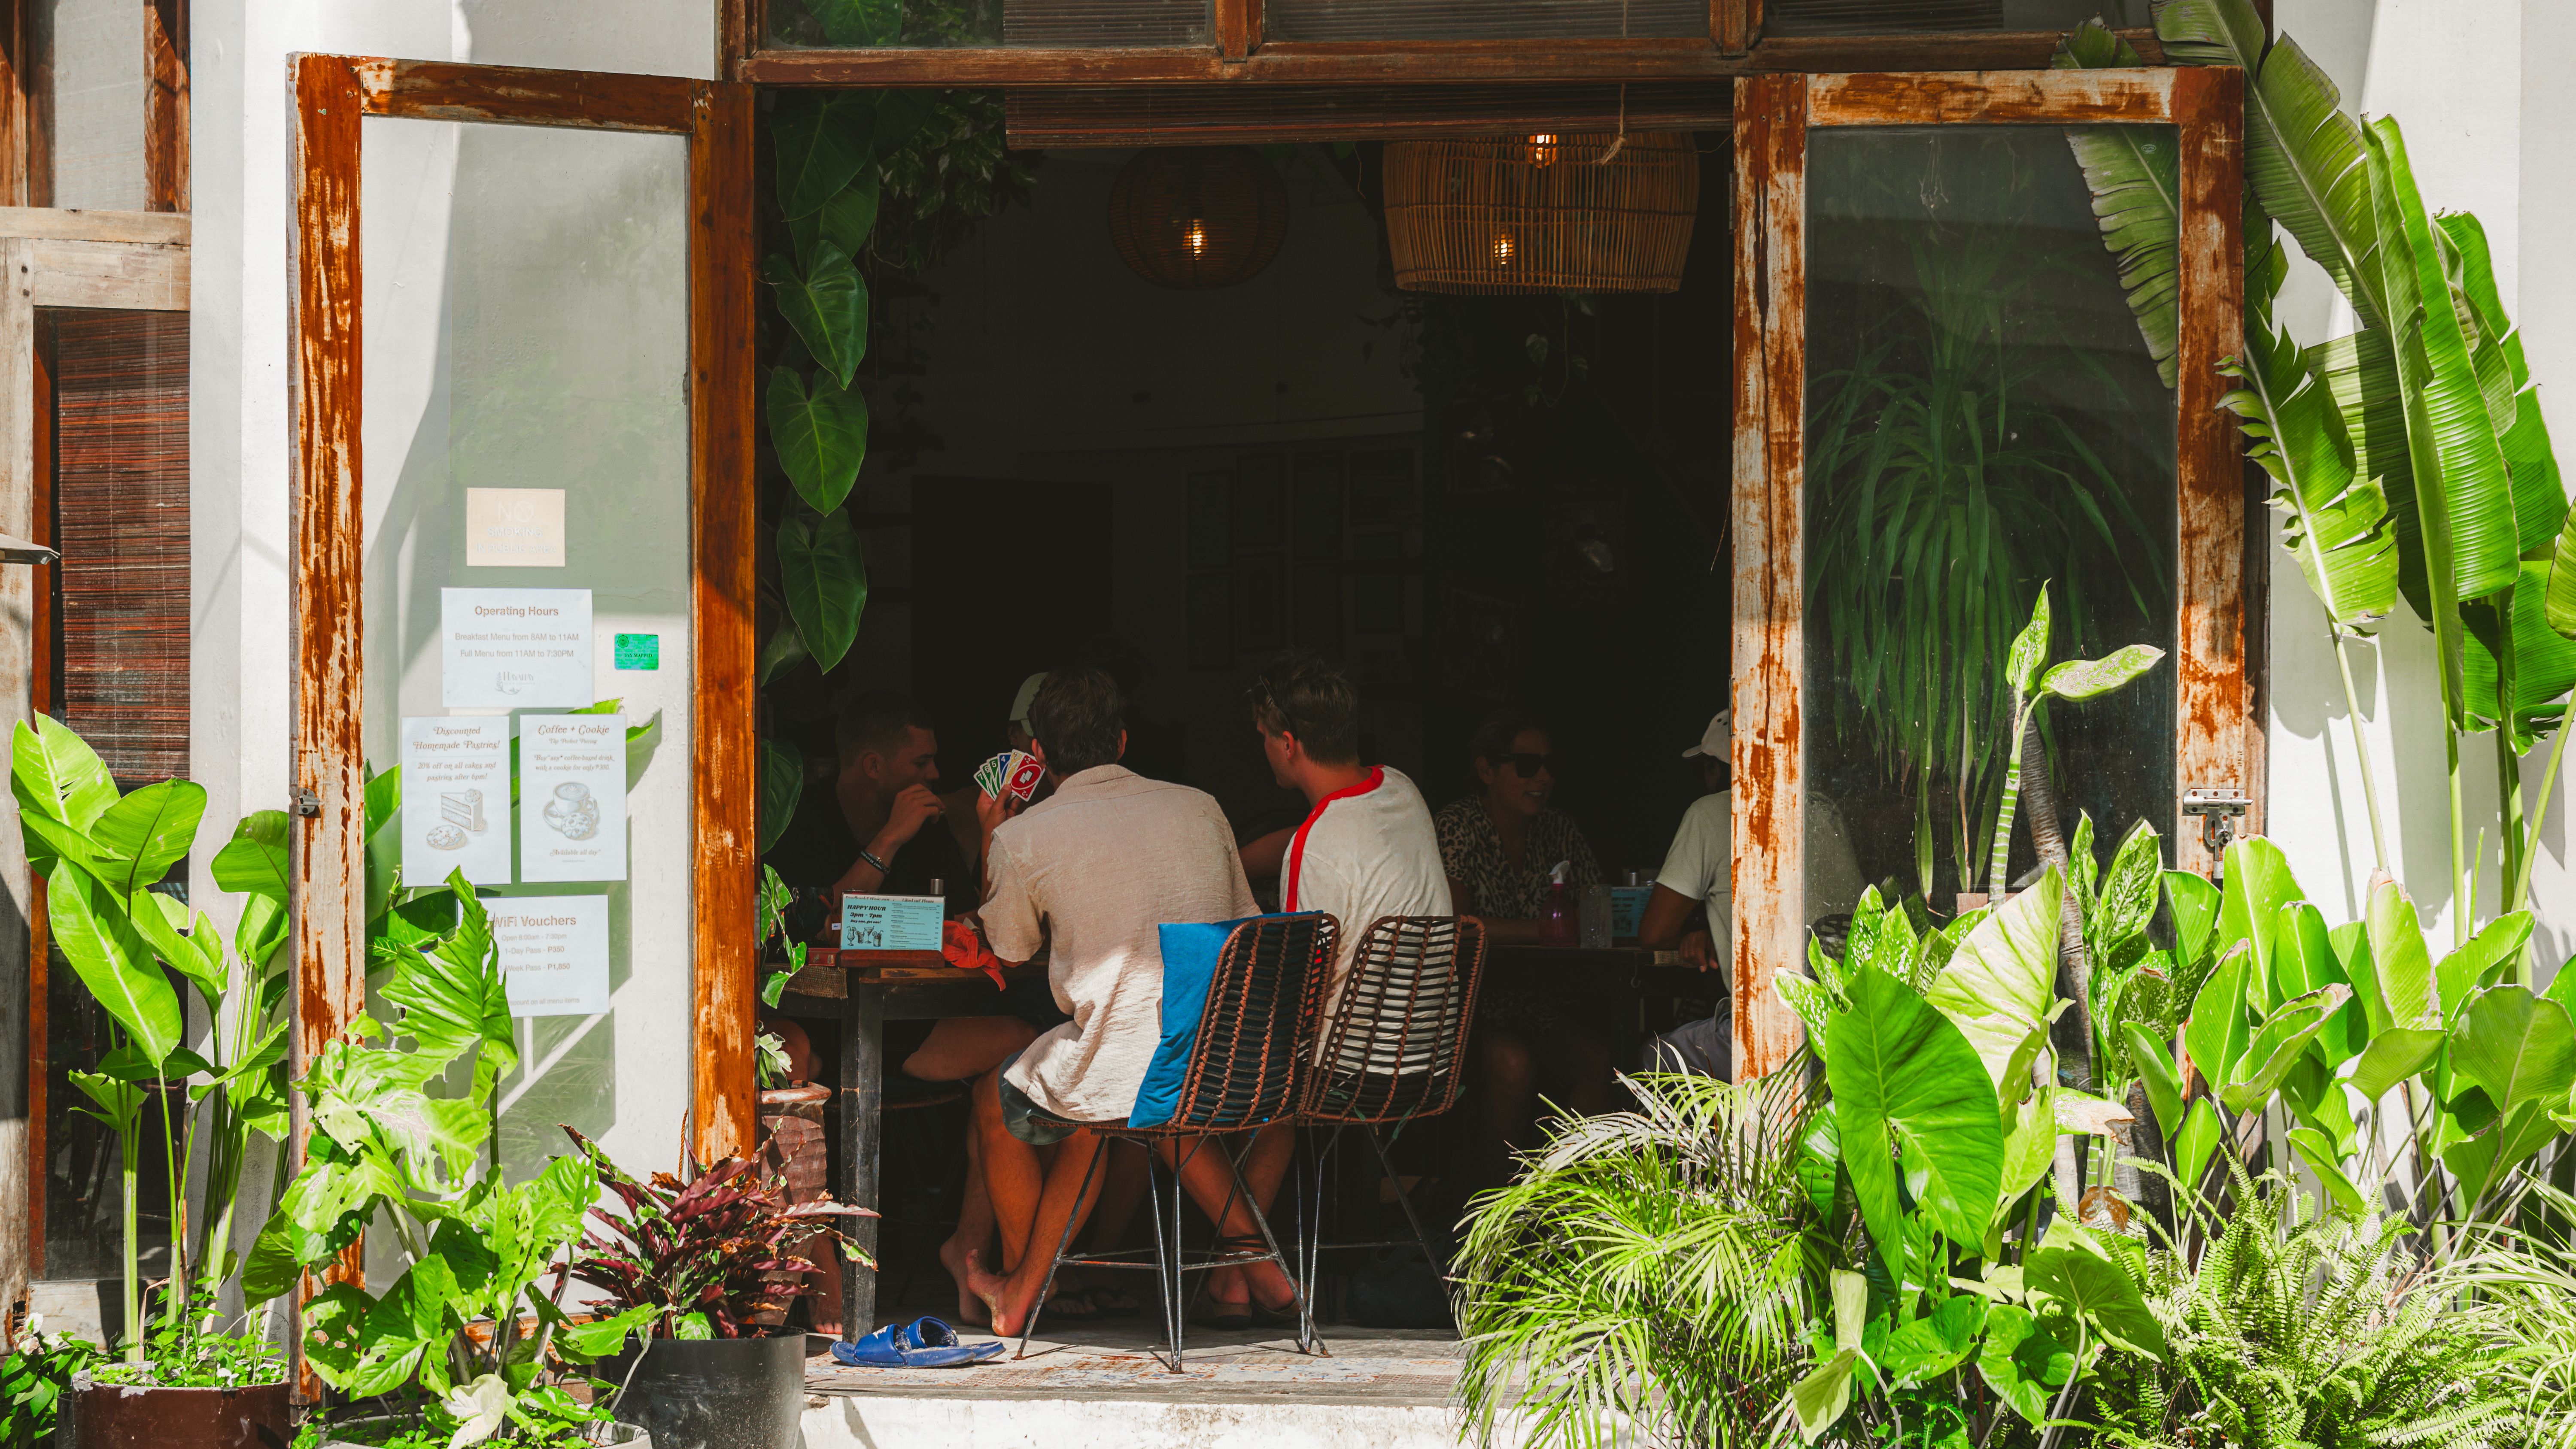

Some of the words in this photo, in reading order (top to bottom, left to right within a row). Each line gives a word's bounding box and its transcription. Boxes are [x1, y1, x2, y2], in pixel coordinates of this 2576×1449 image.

[487, 527, 543, 537] SMOKING
[475, 543, 486, 553] IN
[488, 543, 526, 553] PUBLIC
[529, 543, 557, 554] AREA
[475, 606, 525, 618] Operating
[529, 606, 559, 616] Hours
[455, 633, 488, 641] Breakfast
[433, 727, 481, 736] Discounted
[538, 724, 567, 735] Coffee
[578, 724, 609, 735] Cookie
[413, 741, 460, 751] Homemade
[463, 740, 500, 750] Pastries!
[465, 762, 482, 770] cakes
[485, 761, 496, 770] and
[426, 774, 453, 782] pastries
[471, 773, 488, 782] 6pm!
[550, 849, 578, 857] Available
[493, 916, 516, 928] WiFi
[521, 915, 576, 927] Vouchers
[504, 947, 523, 955] 1-Day
